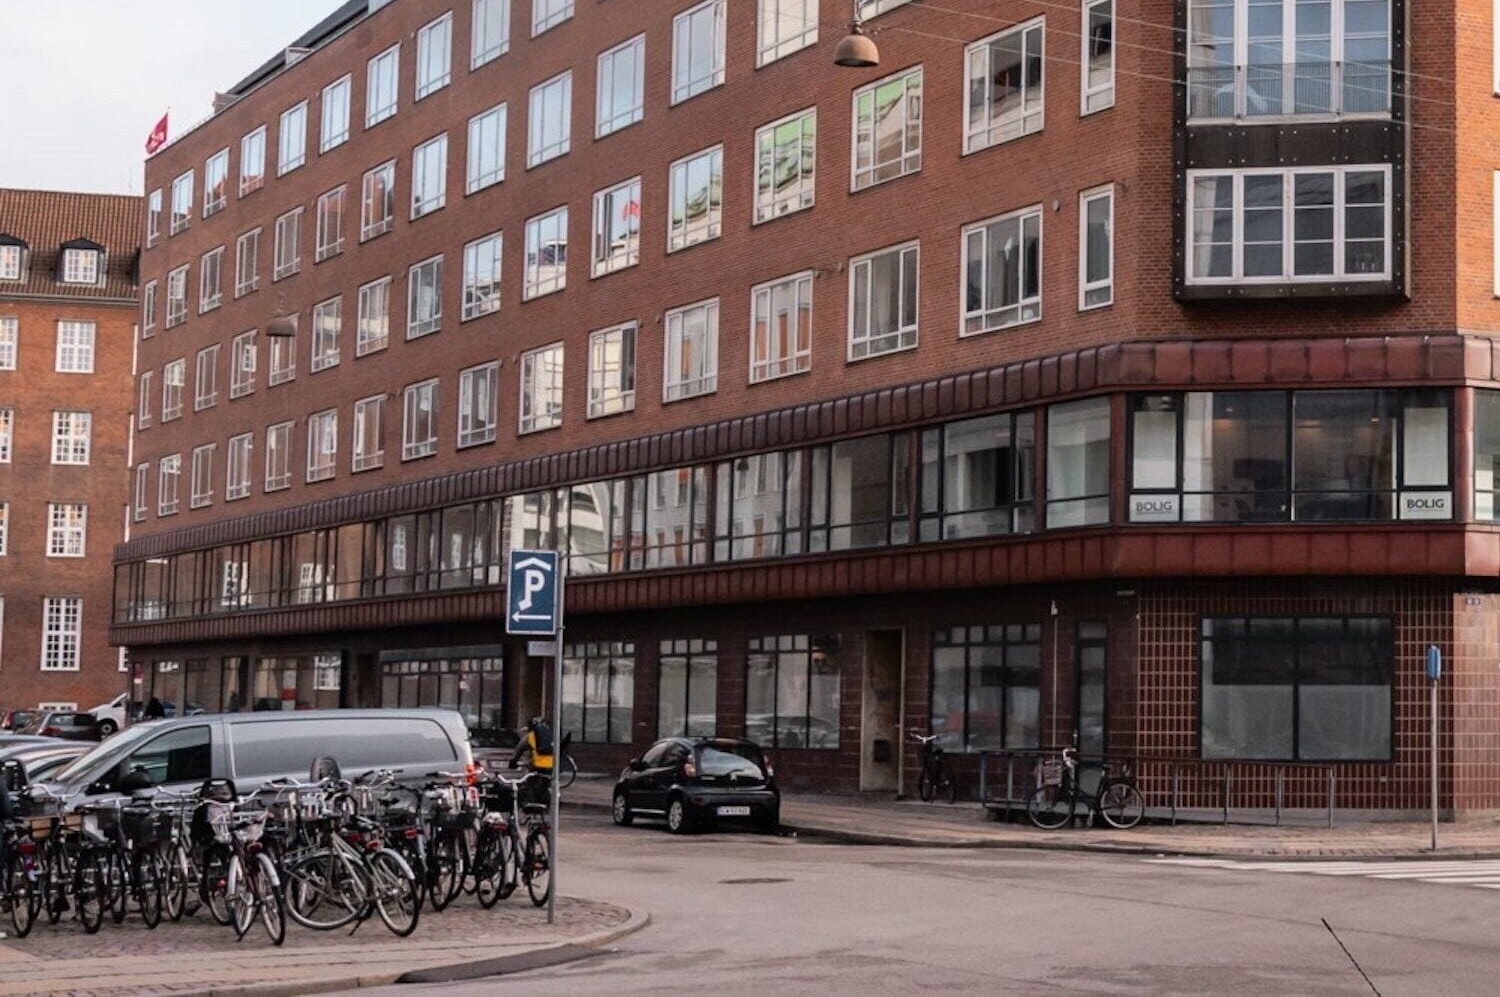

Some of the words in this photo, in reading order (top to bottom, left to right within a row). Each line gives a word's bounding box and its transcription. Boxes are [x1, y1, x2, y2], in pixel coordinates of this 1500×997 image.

[1136, 501, 1173, 512] BOLIG
[1407, 498, 1445, 509] BOLIG
[520, 569, 546, 608] P
